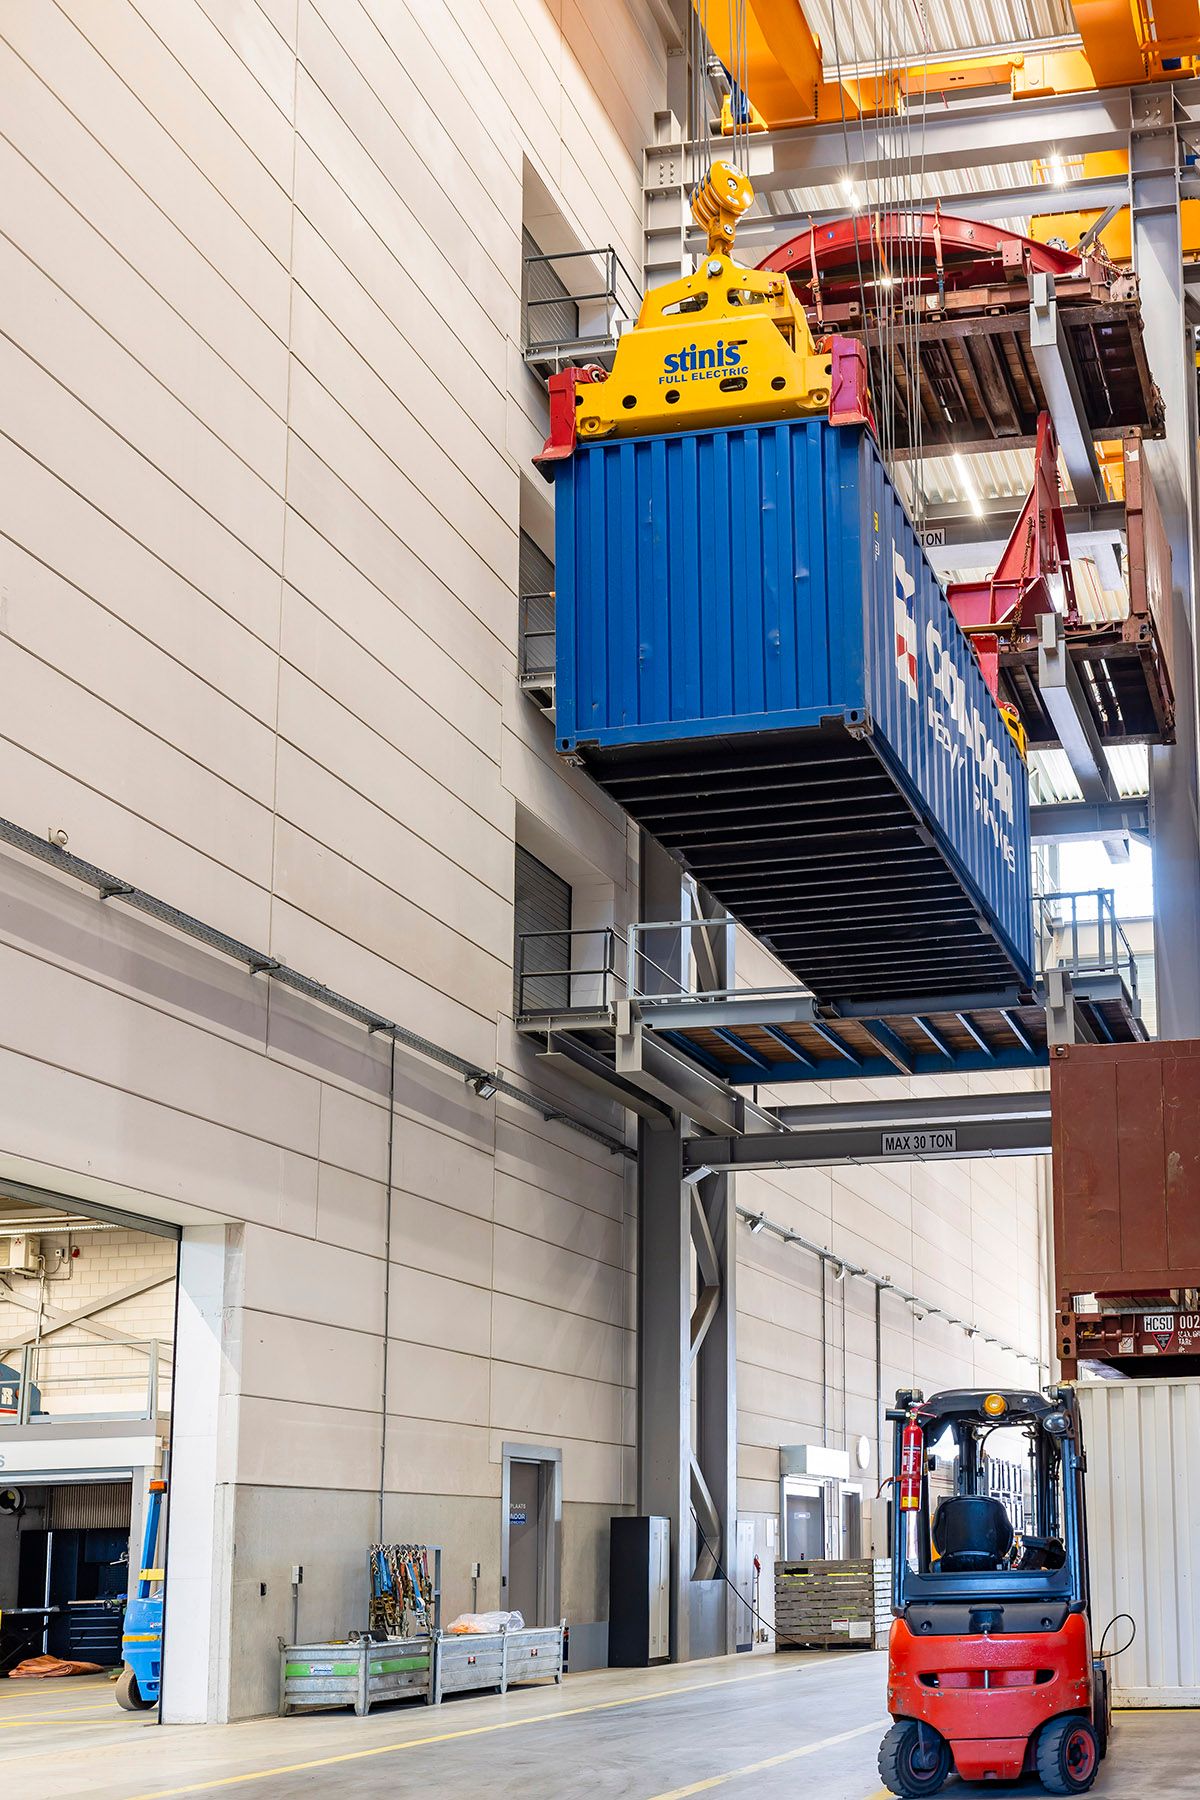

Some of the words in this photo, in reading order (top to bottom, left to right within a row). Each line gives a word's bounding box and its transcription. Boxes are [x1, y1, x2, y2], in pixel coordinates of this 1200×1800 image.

[664, 340, 741, 374] stinis
[658, 374, 688, 385] FULL
[691, 366, 749, 381] ELECTRIC
[885, 1136, 911, 1151] MAX
[913, 1135, 926, 1149] 30
[929, 1134, 953, 1148] TON
[1145, 1317, 1173, 1331] HCSU
